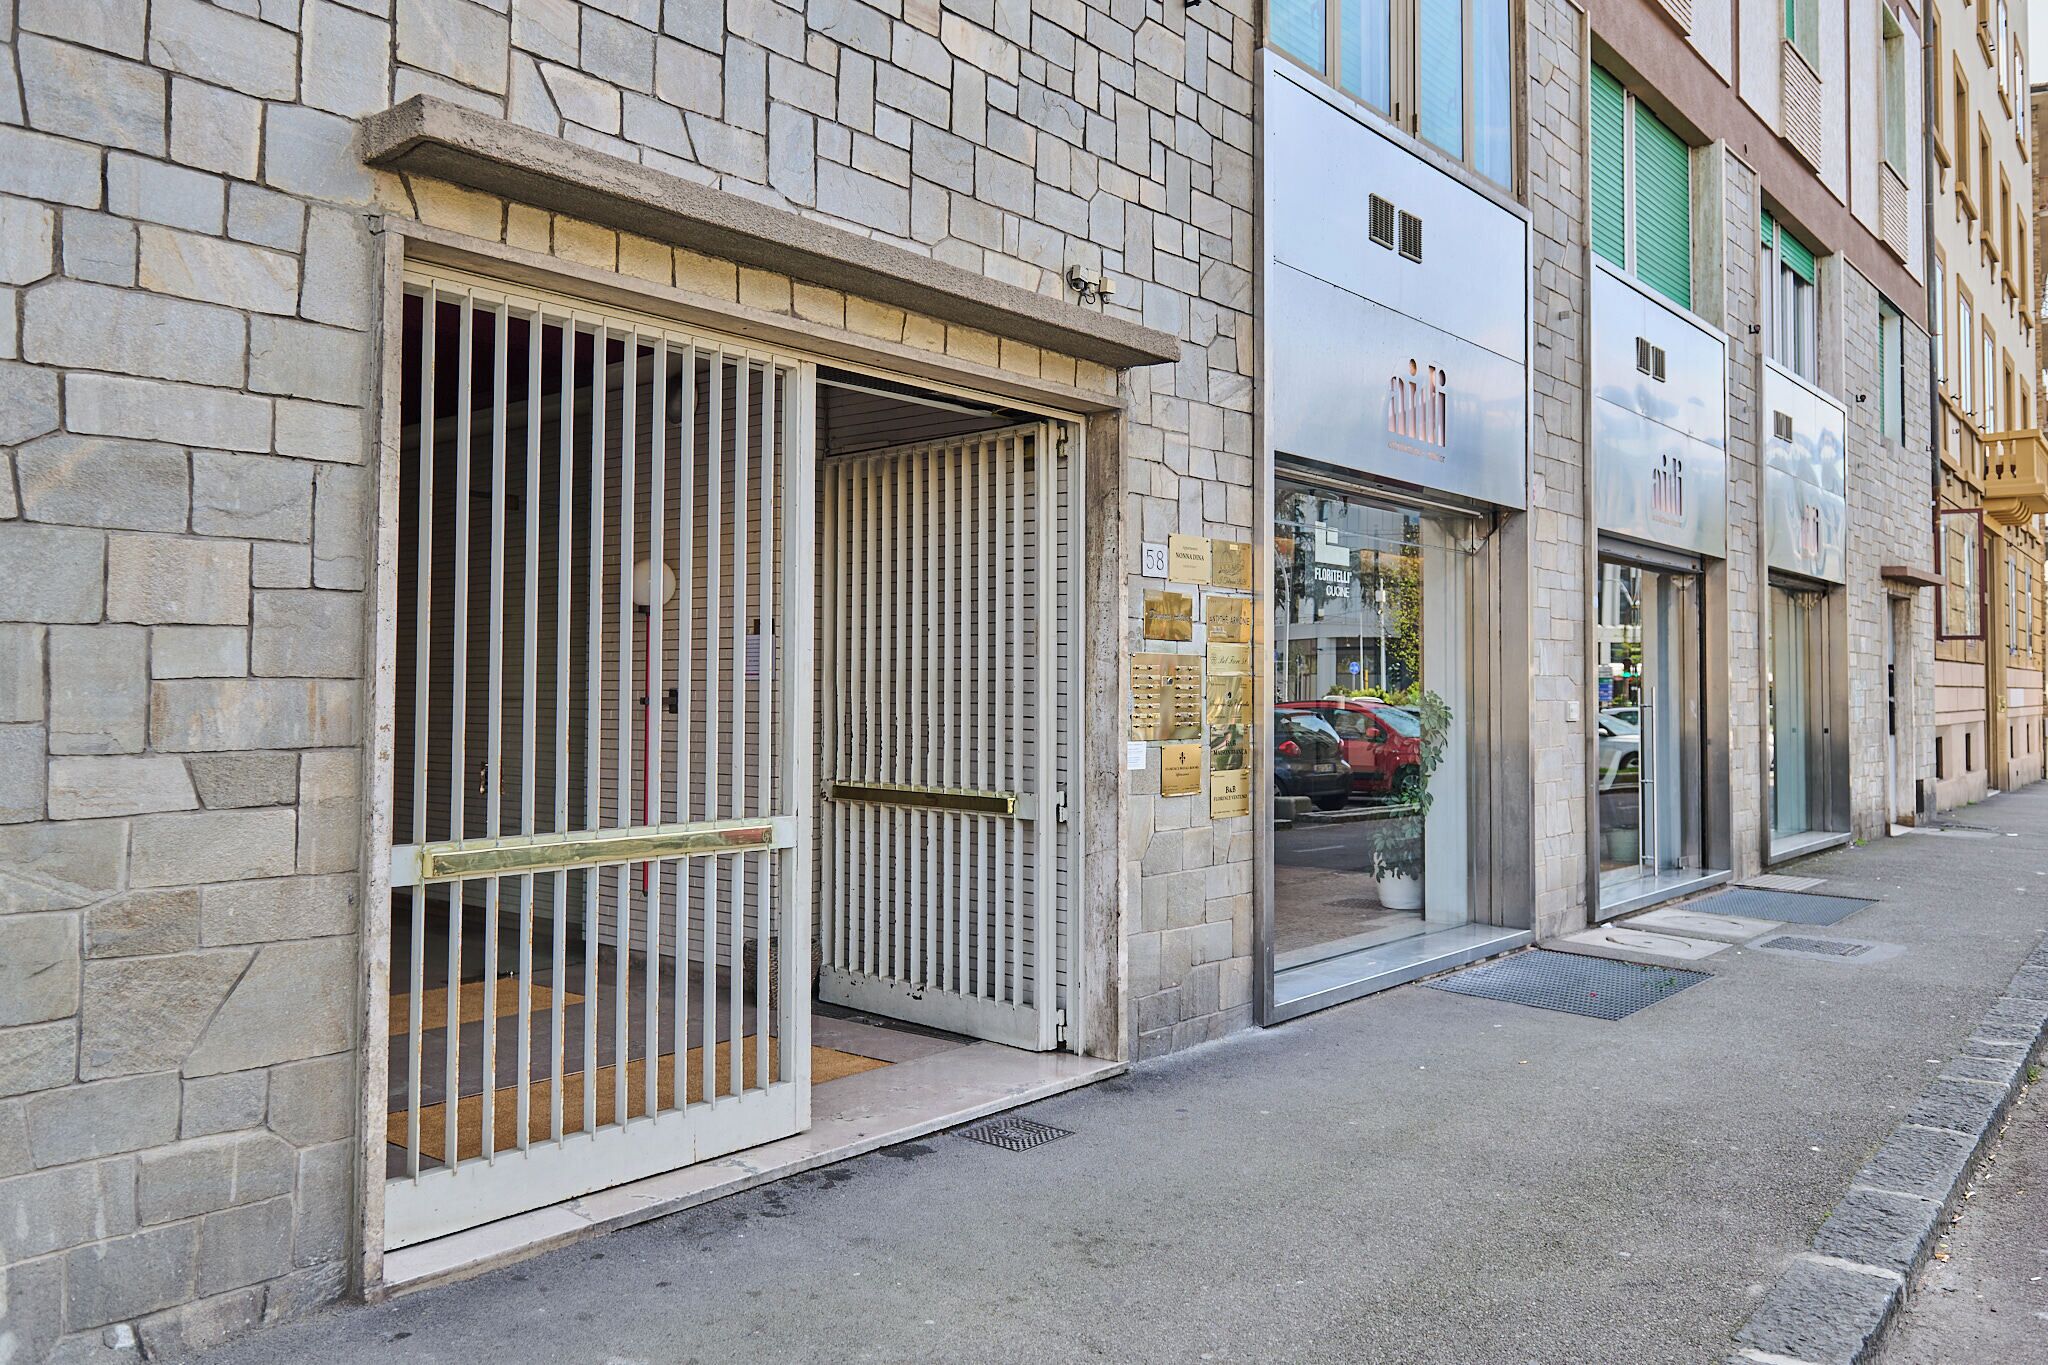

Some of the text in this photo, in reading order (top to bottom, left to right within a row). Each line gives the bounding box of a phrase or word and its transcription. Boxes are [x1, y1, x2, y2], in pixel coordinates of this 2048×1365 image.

[1146, 549, 1165, 570] 58
[1314, 567, 1351, 584] FLORITELLI
[1326, 585, 1350, 598] CUCINE
[1225, 785, 1237, 794] B&B
